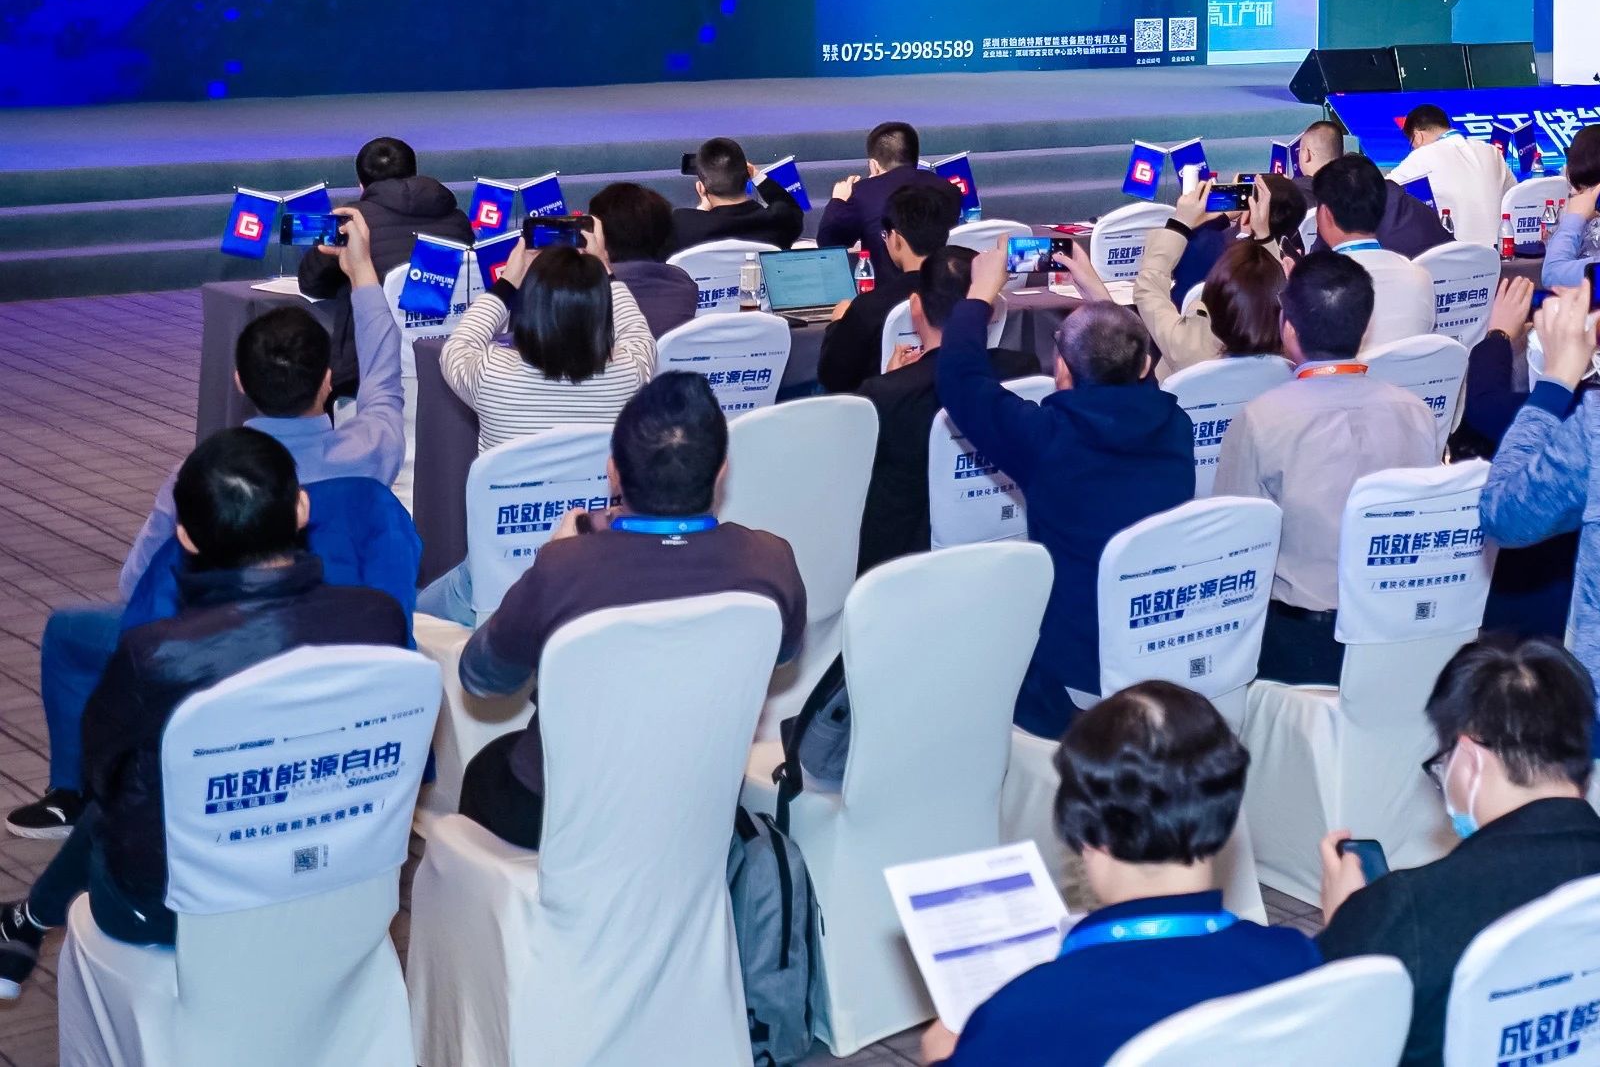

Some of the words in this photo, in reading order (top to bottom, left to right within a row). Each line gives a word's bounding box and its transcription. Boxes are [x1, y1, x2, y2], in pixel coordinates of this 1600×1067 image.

[841, 40, 973, 62] 0755-29985589
[1135, 163, 1152, 182] G
[238, 215, 261, 239] G
[480, 203, 499, 225] G
[1368, 525, 1486, 556] 成就能源自由
[1129, 569, 1257, 618] 成就能源自由
[1147, 620, 1240, 653] 模块化储能系统领导者
[207, 741, 402, 801] 成就能源自由
[229, 802, 374, 841] 模块化储能系统领导者
